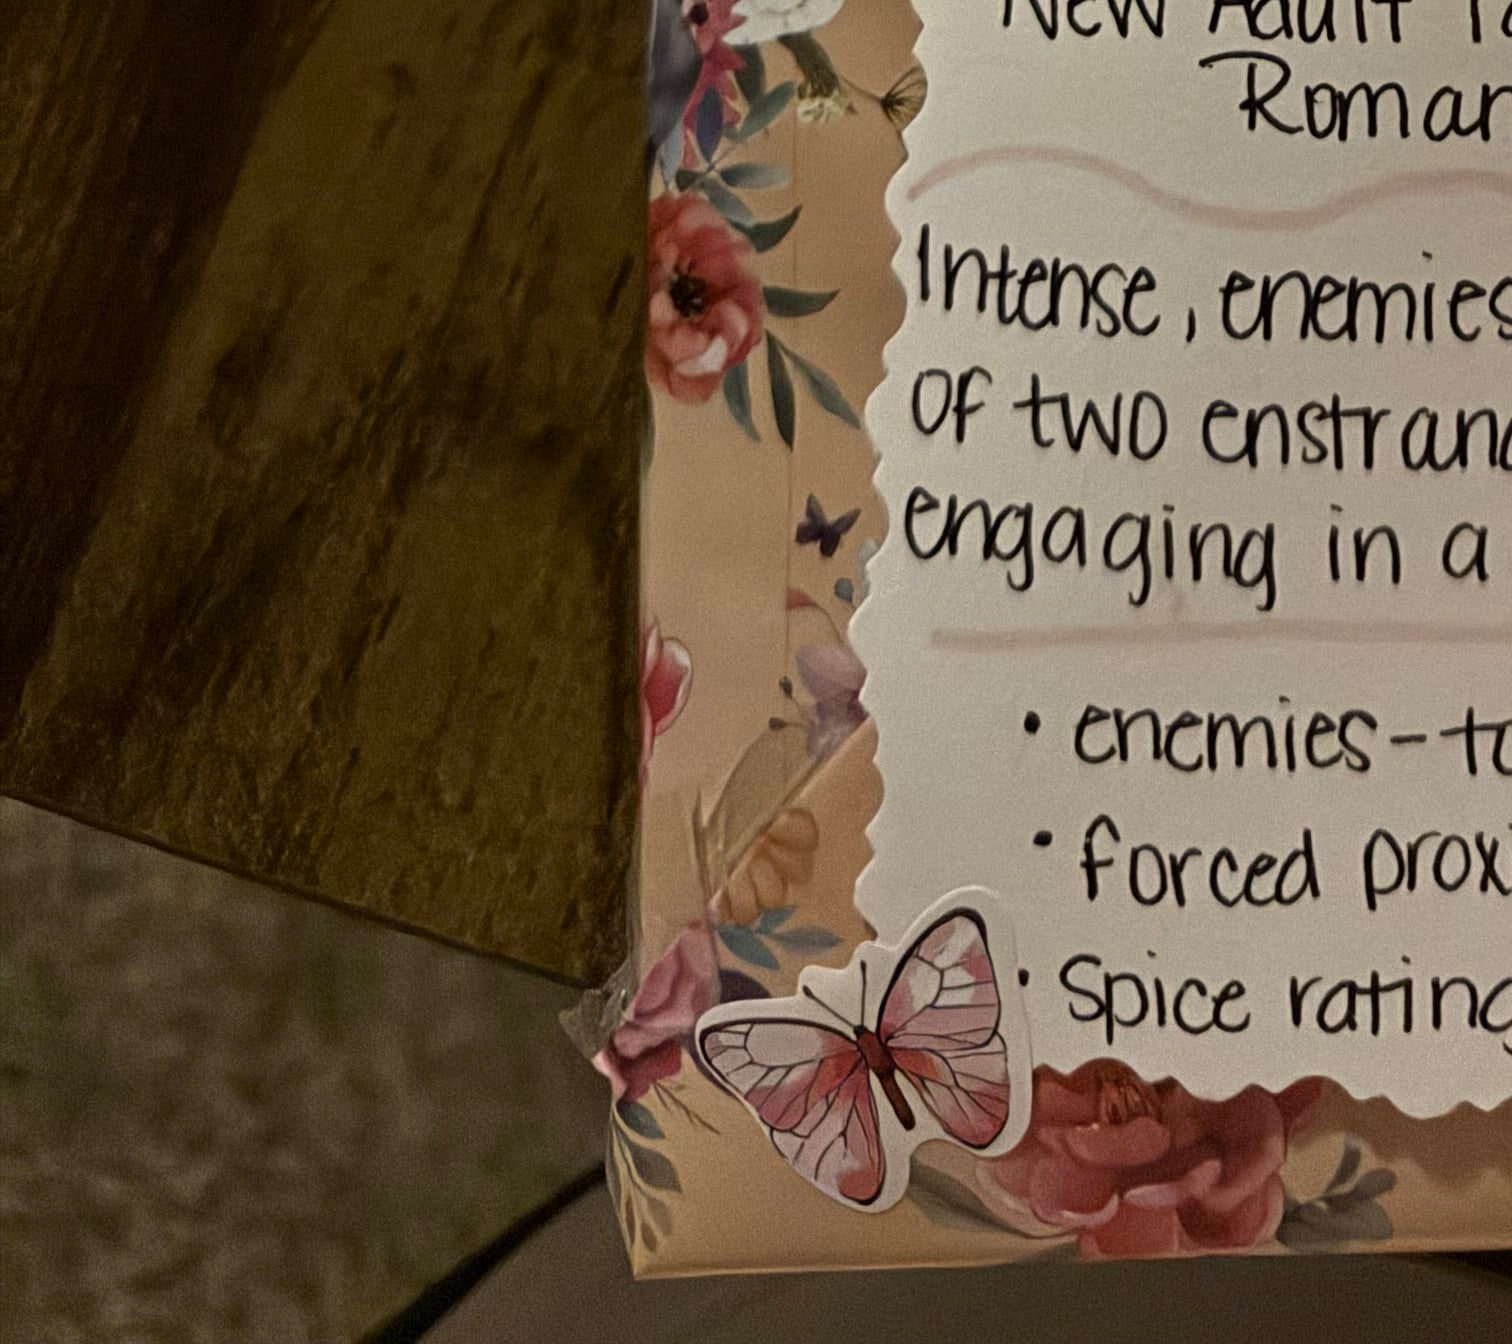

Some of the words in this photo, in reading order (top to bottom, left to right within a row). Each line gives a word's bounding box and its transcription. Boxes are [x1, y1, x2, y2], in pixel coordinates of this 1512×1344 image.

[1012, 373, 1168, 462] two
[904, 486, 1277, 612] engaging
[1328, 503, 1402, 585] in
[1442, 520, 1490, 583] a
[1078, 813, 1320, 907] forced
